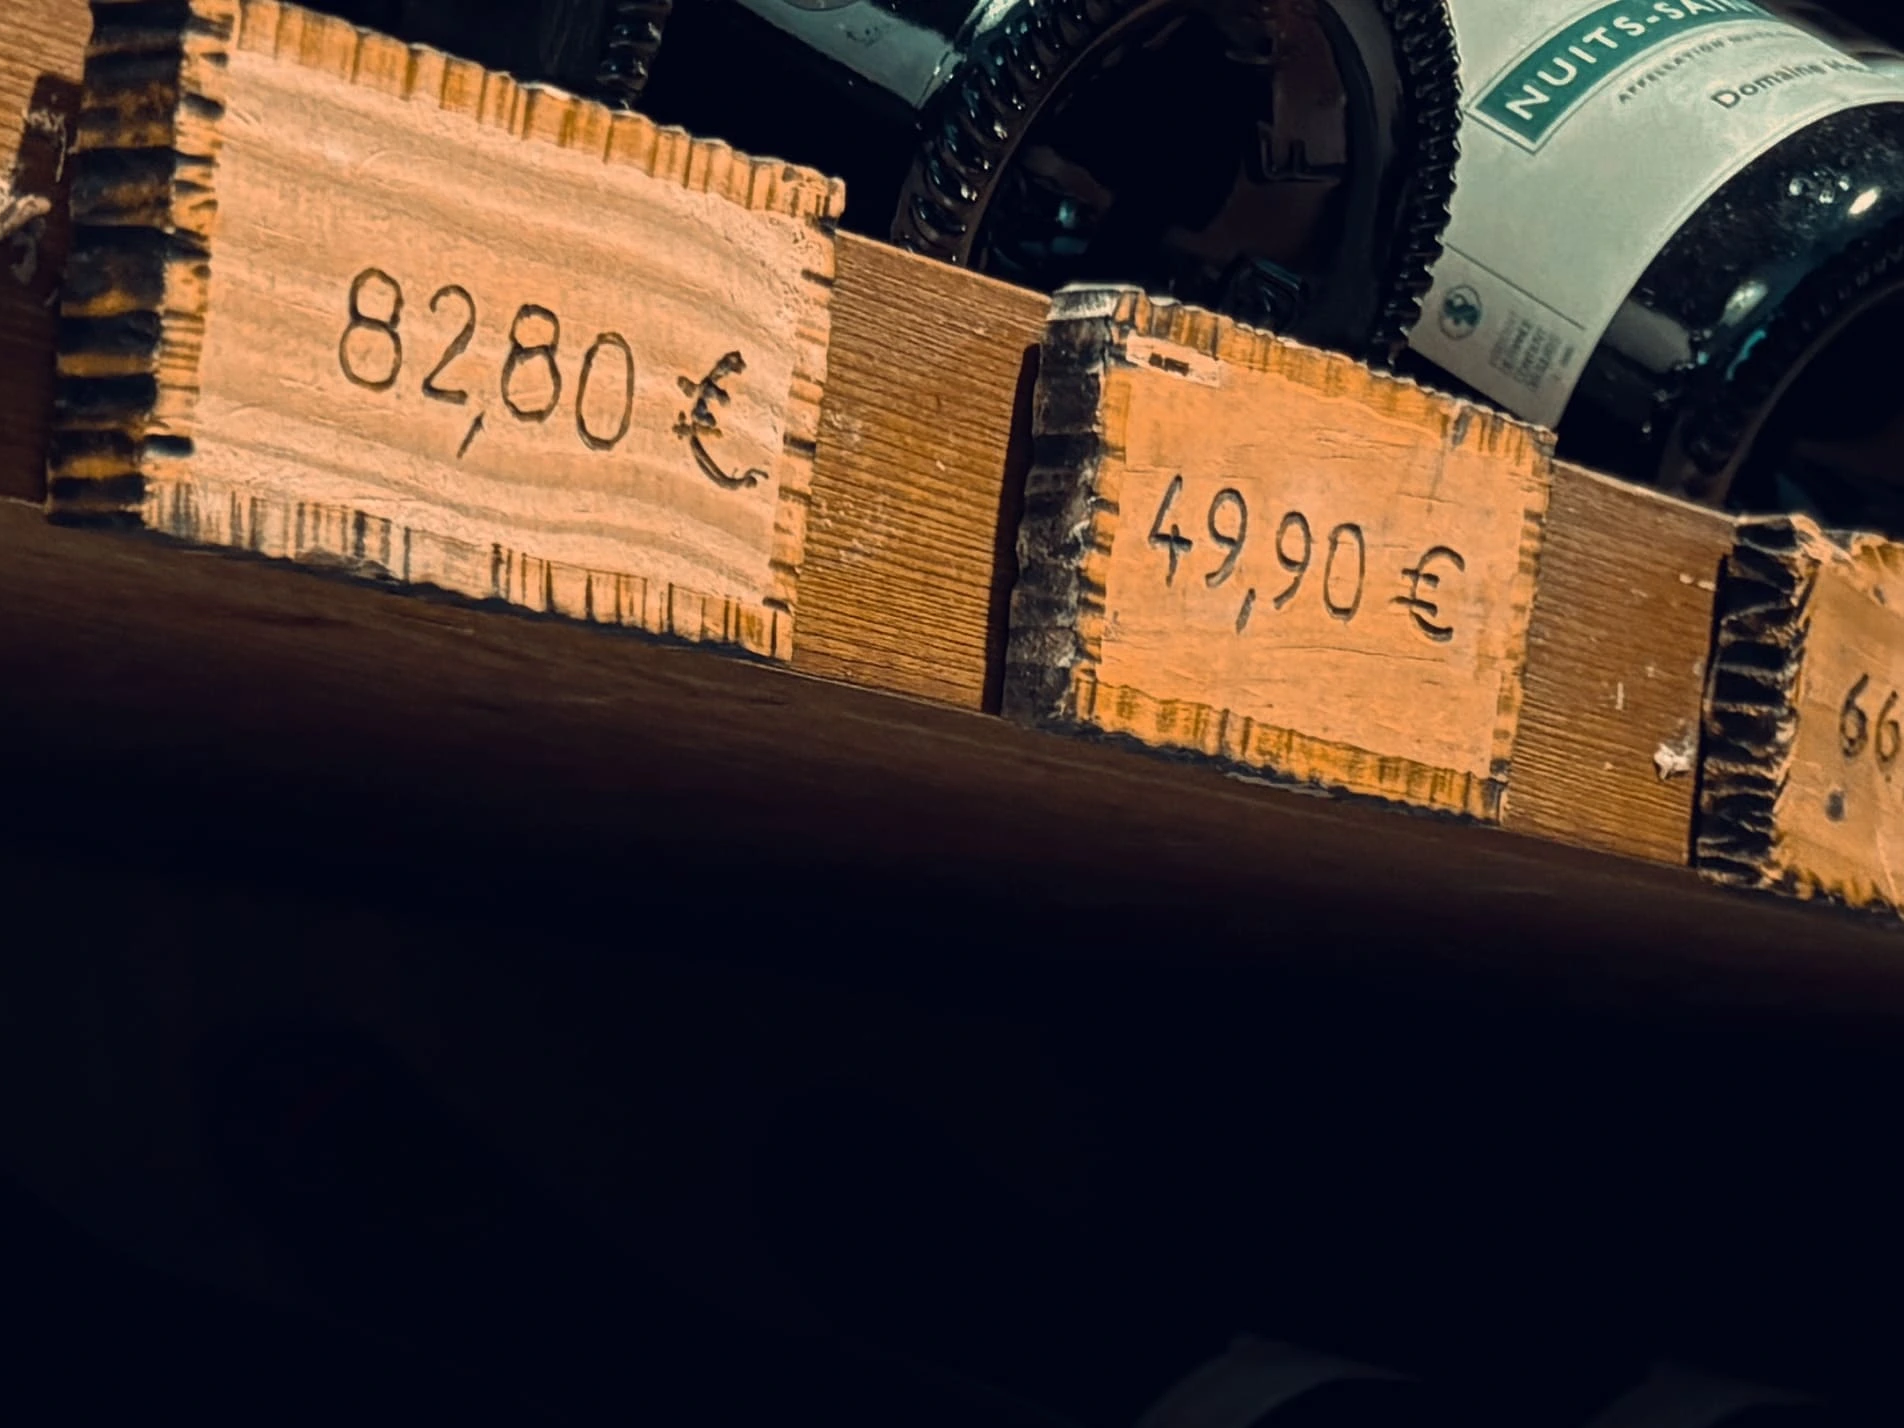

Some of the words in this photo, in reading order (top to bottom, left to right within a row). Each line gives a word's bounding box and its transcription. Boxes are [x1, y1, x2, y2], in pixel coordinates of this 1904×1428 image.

[339, 267, 635, 459] 82,80
[672, 350, 770, 491] €
[1147, 474, 1365, 634] 49,90
[1391, 545, 1465, 643] €
